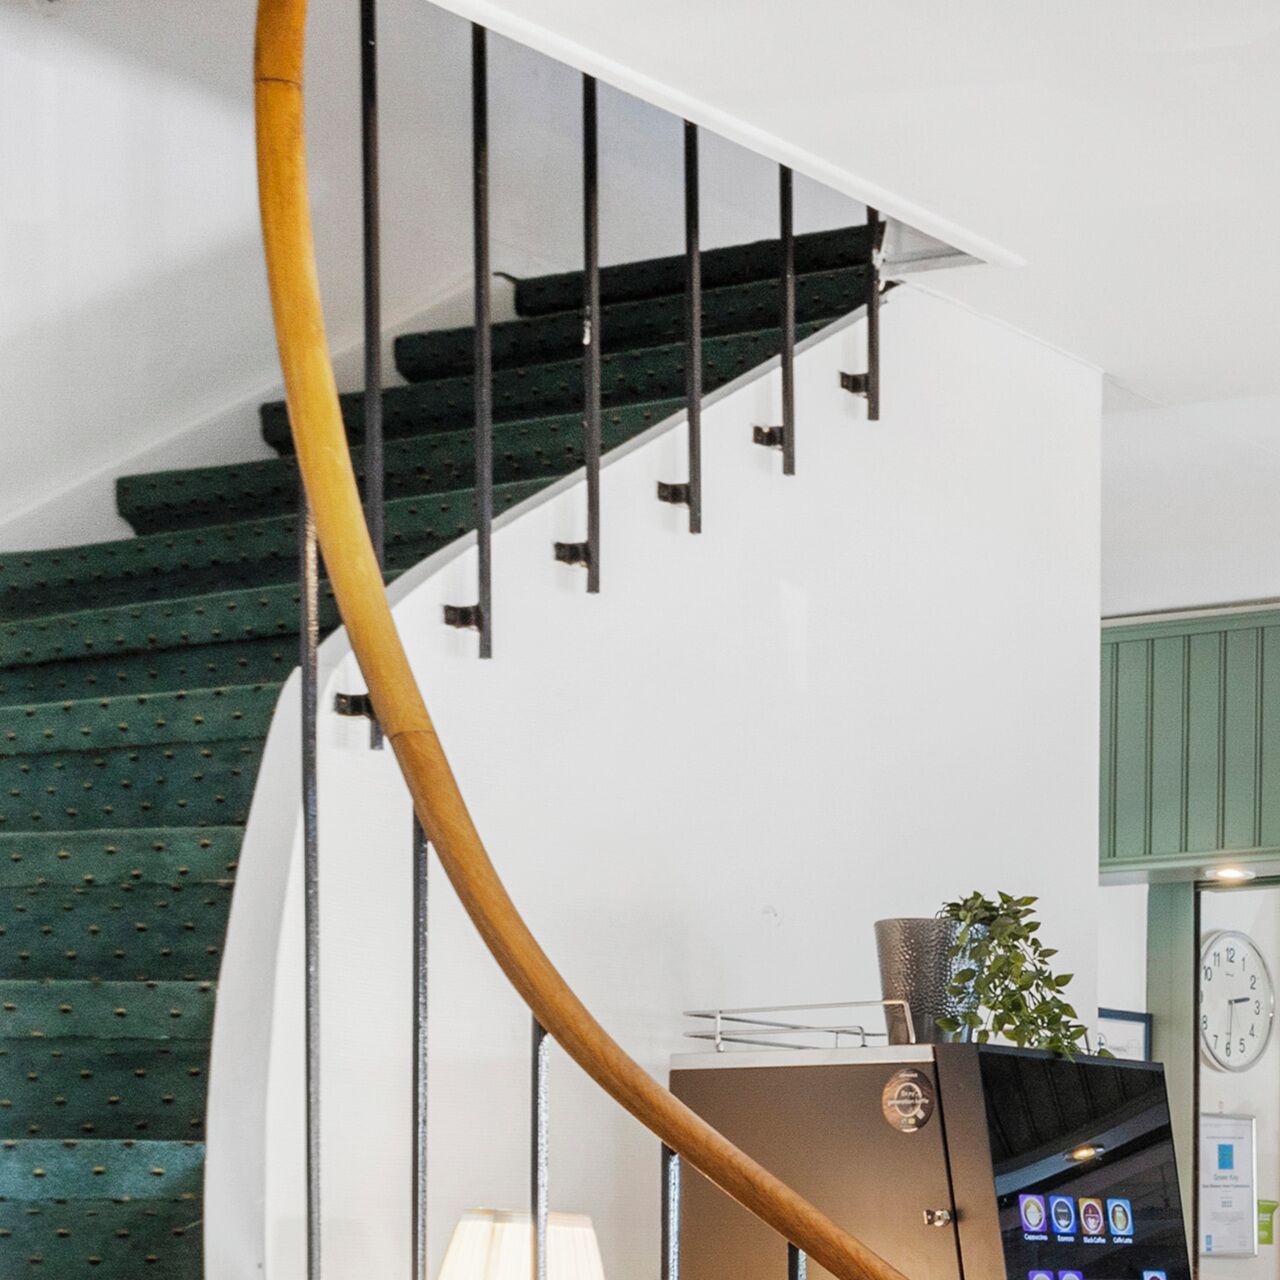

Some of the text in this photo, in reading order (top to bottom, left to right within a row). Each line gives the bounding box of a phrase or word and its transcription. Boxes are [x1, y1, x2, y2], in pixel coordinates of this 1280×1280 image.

[1213, 951, 1220, 967] 11
[1226, 947, 1235, 963] 12
[1203, 965, 1212, 981] 10
[1250, 974, 1256, 990] 2
[1254, 1000, 1260, 1015] 3
[1202, 1014, 1208, 1030] 8
[1249, 1023, 1255, 1037] 4
[1213, 1034, 1218, 1049] 7
[1225, 1041, 1231, 1057] 6
[1239, 1038, 1245, 1053] 5
